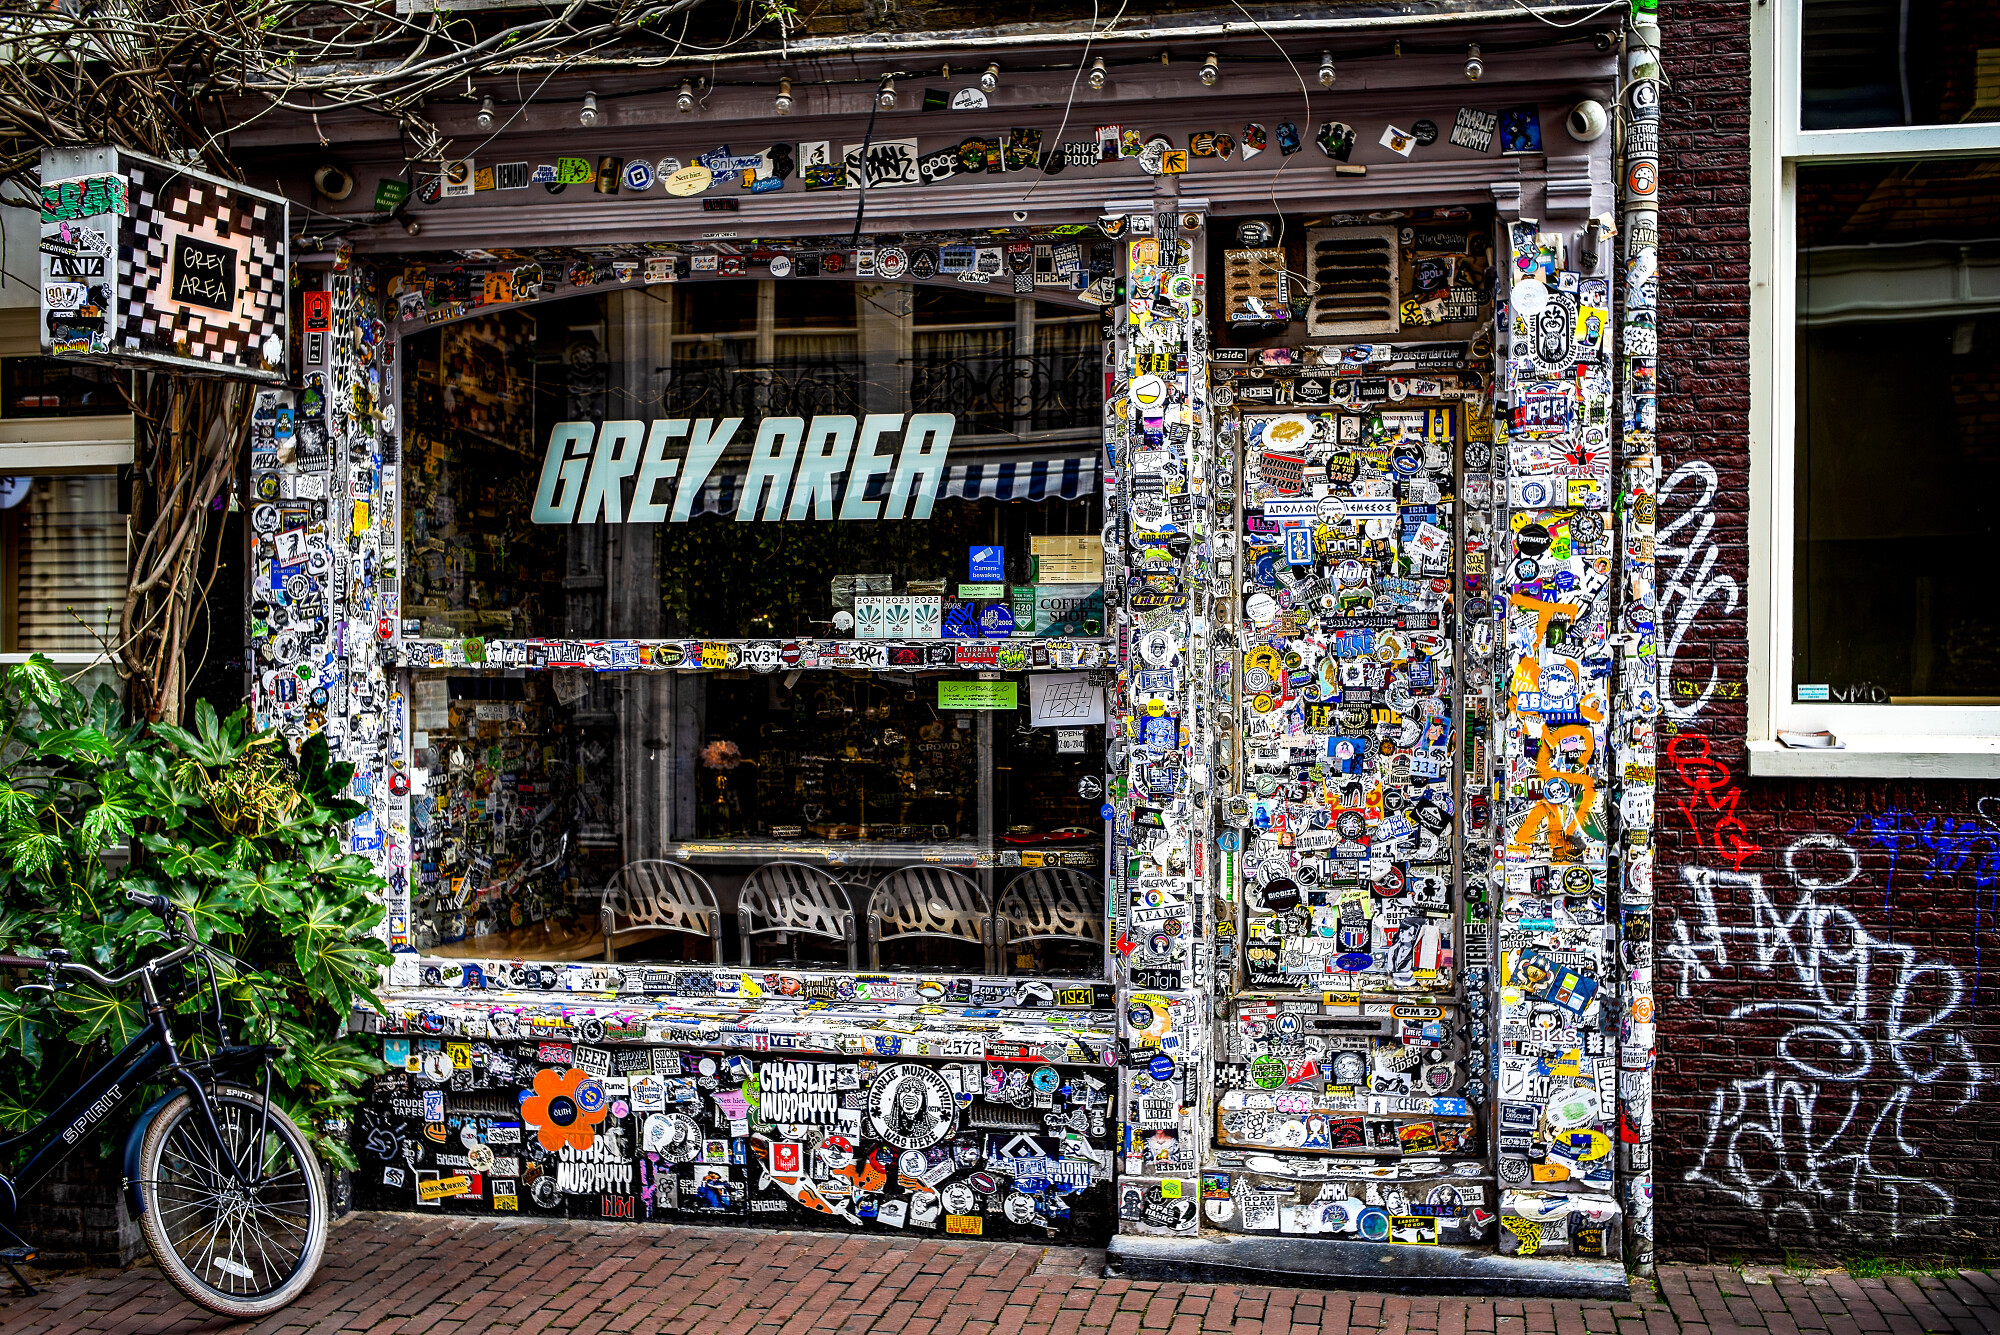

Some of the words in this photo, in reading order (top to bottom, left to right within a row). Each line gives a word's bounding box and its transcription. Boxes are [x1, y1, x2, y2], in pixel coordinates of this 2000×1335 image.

[1457, 106, 1497, 131] CHARLIE
[1064, 142, 1099, 154] CAVE
[1064, 155, 1098, 166] POOL
[1008, 244, 1032, 254] Shiloh
[184, 247, 225, 276] GREY
[180, 277, 227, 301] AREA
[1215, 351, 1244, 360] yside
[1334, 455, 1355, 466] BURN
[531, 417, 743, 524] GREY
[735, 412, 956, 521] AREA
[1341, 465, 1355, 474] THE
[1331, 471, 1353, 482] BASS
[1408, 505, 1428, 514] IERI
[1251, 516, 1276, 527] TNS
[1409, 514, 1428, 522] OGGI
[1424, 555, 1447, 567] RAP
[1040, 598, 1097, 610] COFFEE
[301, 607, 322, 618] TOY
[1050, 610, 1089, 622] SHOP
[704, 642, 727, 652] ANTI
[1046, 642, 1073, 650] SAUCE
[703, 658, 725, 667] KVM
[943, 685, 959, 693] NO
[962, 685, 1010, 693] TOBACCO
[1465, 924, 1486, 934] TKC
[1502, 939, 1533, 949] BIRDS
[1138, 971, 1179, 991] 2high
[1061, 988, 1093, 1006] 1931
[1397, 1007, 1421, 1016] CPM
[1423, 1007, 1438, 1016] 22
[1282, 1019, 1294, 1029] M
[987, 1043, 1020, 1054] Ketchup
[1162, 1036, 1179, 1050] FUN
[577, 1045, 608, 1068] SEER
[1622, 1055, 1647, 1065] DANSEN
[655, 1059, 680, 1069] SEER
[761, 1063, 836, 1092] CHARLIE
[870, 1068, 899, 1106] CHARLIE
[226, 1088, 254, 1100] SPIRIT
[393, 1098, 425, 1107] CRUDE
[761, 1093, 838, 1123] MURPHYYY
[62, 1084, 123, 1145] SPIRIT
[393, 1107, 425, 1117] TAPES
[884, 1129, 907, 1149] WAS
[909, 1131, 939, 1149] HERE
